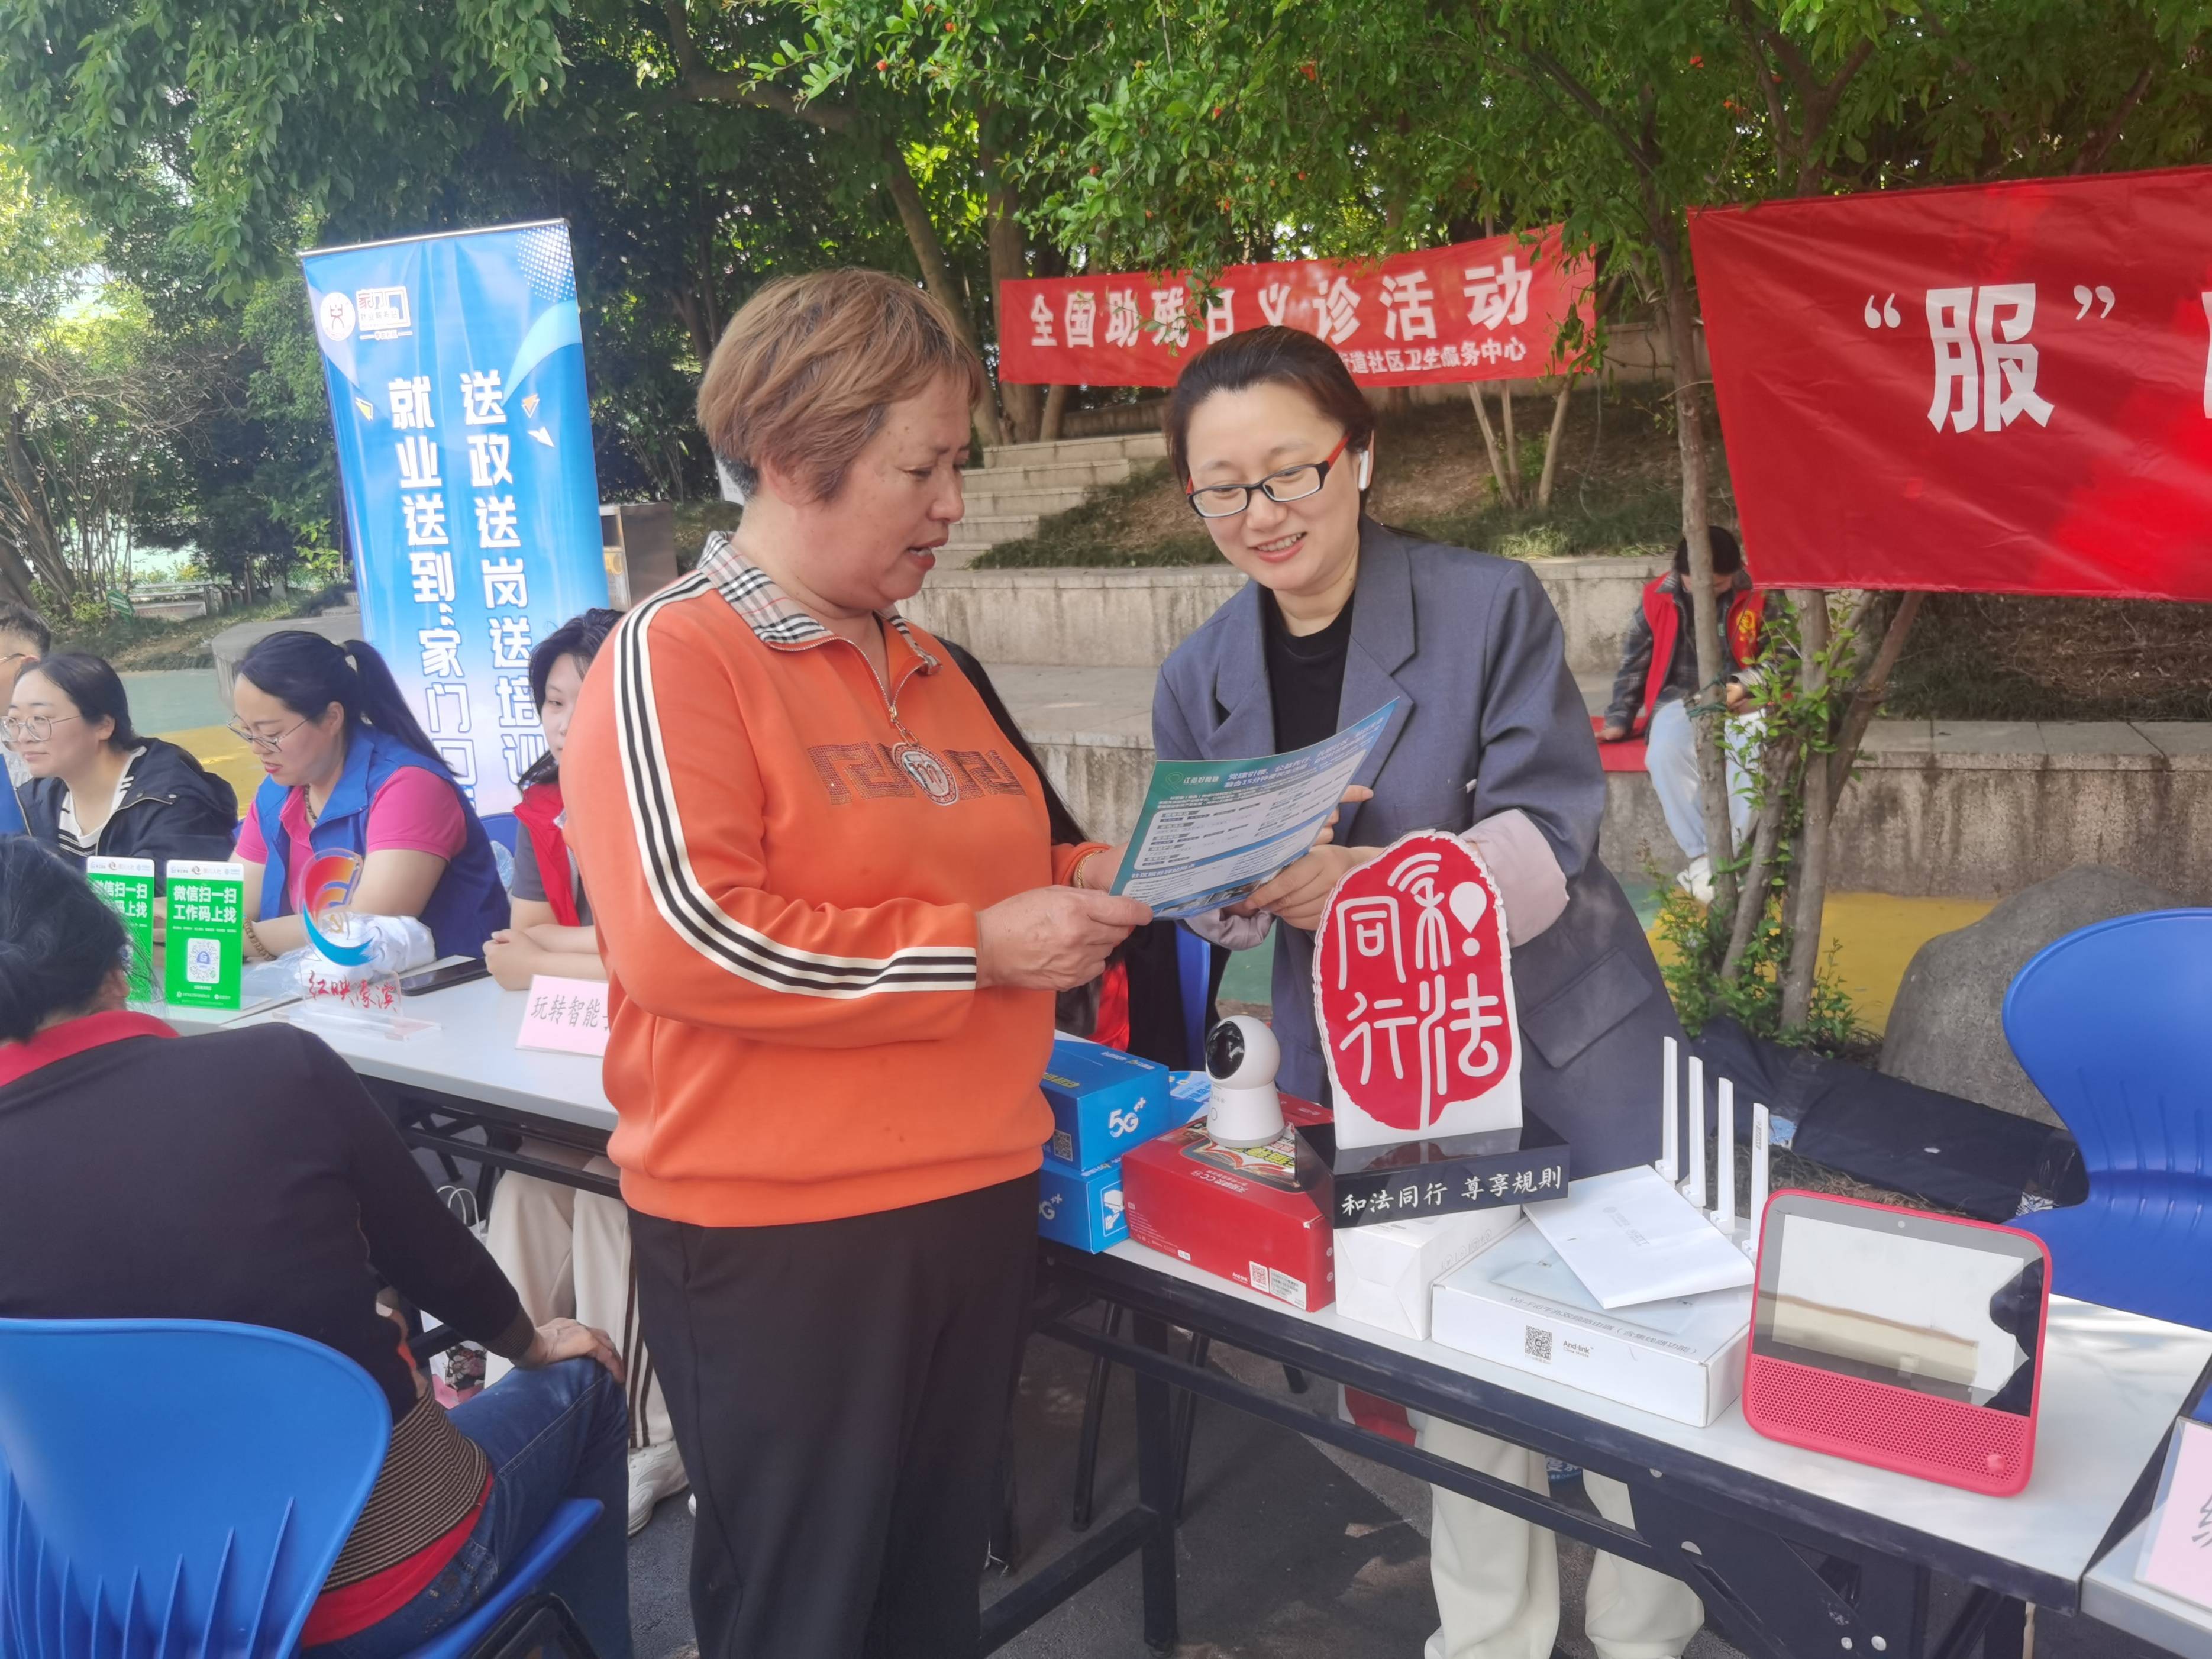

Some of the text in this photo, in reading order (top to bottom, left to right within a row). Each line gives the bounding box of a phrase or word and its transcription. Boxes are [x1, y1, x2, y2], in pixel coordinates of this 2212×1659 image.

[1030, 256, 1533, 348] 全国助残日义诊活动
[1865, 284, 2212, 432] “服”
[460, 369, 545, 786] 送政送岗送培训
[112, 900, 147, 918] 码上找
[173, 885, 237, 904] 微信扫一扫
[173, 904, 237, 924] 工作码上找
[1341, 1182, 1448, 1216] 和法同行
